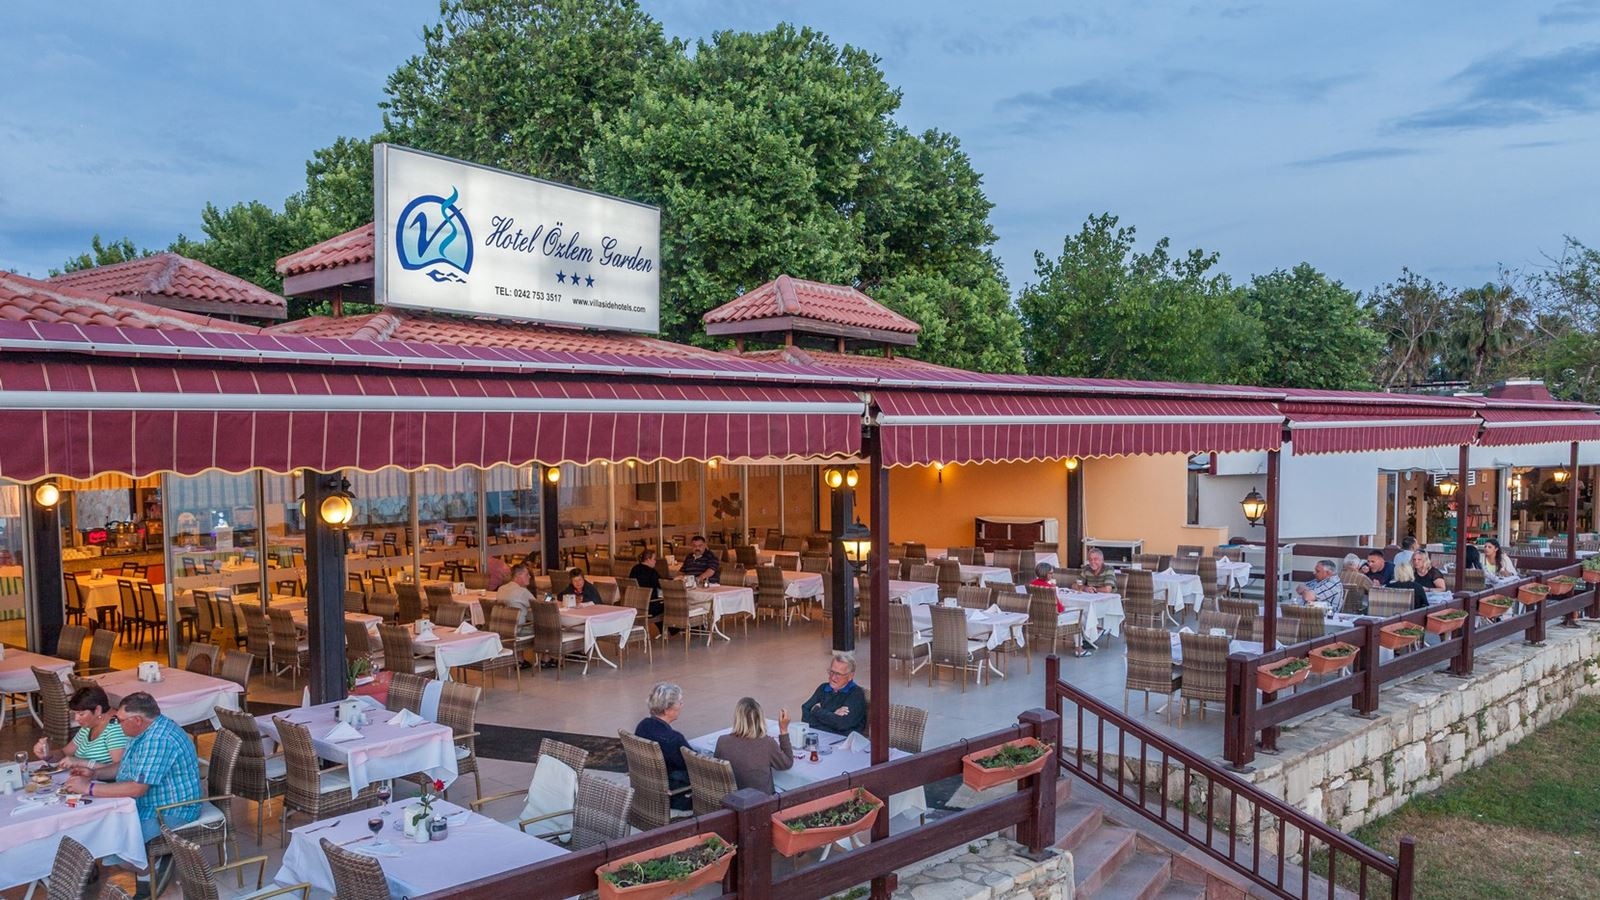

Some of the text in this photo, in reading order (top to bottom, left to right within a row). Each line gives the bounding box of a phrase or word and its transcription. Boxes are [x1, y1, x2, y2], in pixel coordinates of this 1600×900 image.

[485, 215, 653, 273] Hotel Özlem Garden
[495, 286, 562, 303] TEL: 0242 753 3517
[572, 298, 646, 313] www.villasidehotels.com
